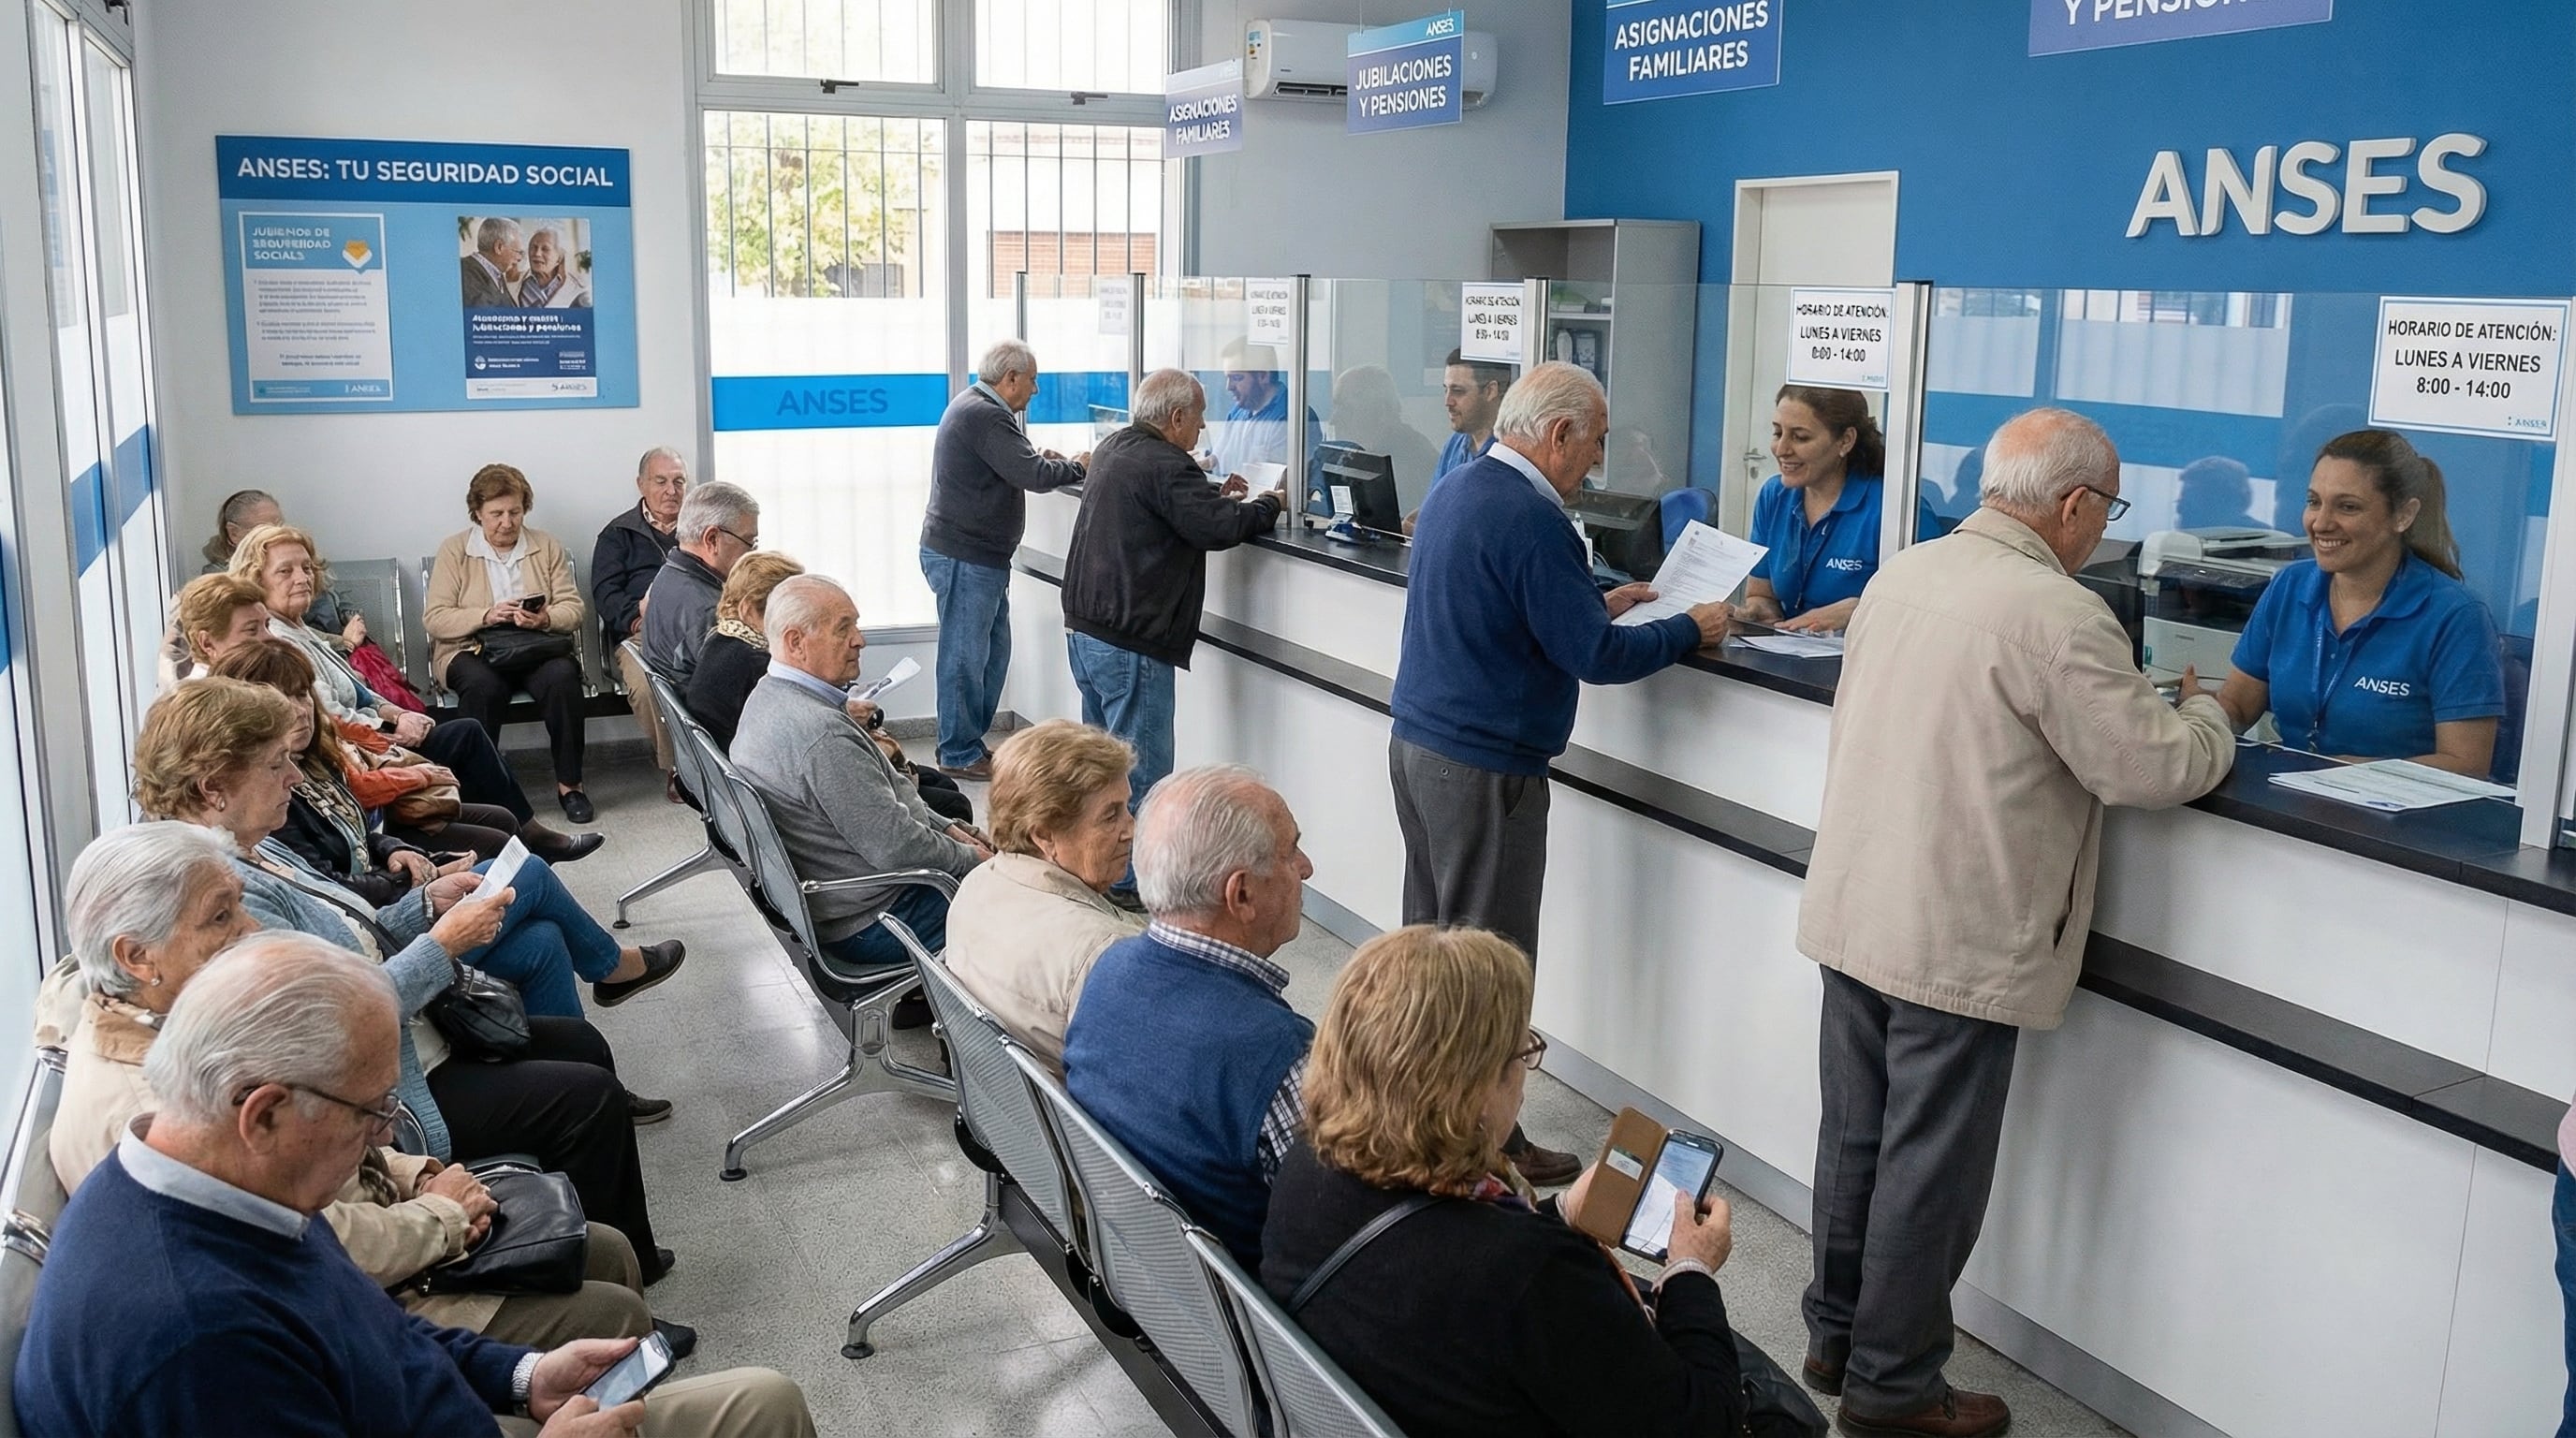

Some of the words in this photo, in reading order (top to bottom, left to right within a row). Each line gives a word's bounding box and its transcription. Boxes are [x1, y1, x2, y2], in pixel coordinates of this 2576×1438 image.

[1614, 0, 1769, 50] ASIGNACIONES
[1355, 55, 1452, 91] JUBILACIONES
[1629, 40, 1749, 81] FAMILIARES
[1359, 96, 1369, 117] Y
[1371, 86, 1446, 116] PENSIONES
[238, 157, 330, 180] ANSES:
[336, 159, 370, 181] TU
[377, 161, 520, 184] SEGURIDAD
[526, 166, 613, 186] SOCIAL
[2125, 133, 2488, 238] ANSES
[1800, 327, 1830, 340] LUNES
[1832, 329, 1839, 340] A
[1841, 328, 1881, 342] VIERNES
[2388, 319, 2451, 337] HORARIO
[2455, 322, 2474, 338] DE
[2478, 321, 2556, 342] ATENCIÓN:
[2395, 349, 2448, 368] LUNES
[2452, 352, 2463, 369] A
[2468, 352, 2540, 373] VIERNES
[2416, 376, 2451, 395] 8:00
[2466, 380, 2511, 399] 14:00
[777, 389, 888, 416] ANSES
[1825, 558, 1863, 571] ANSES
[2354, 676, 2410, 696] ANSES
